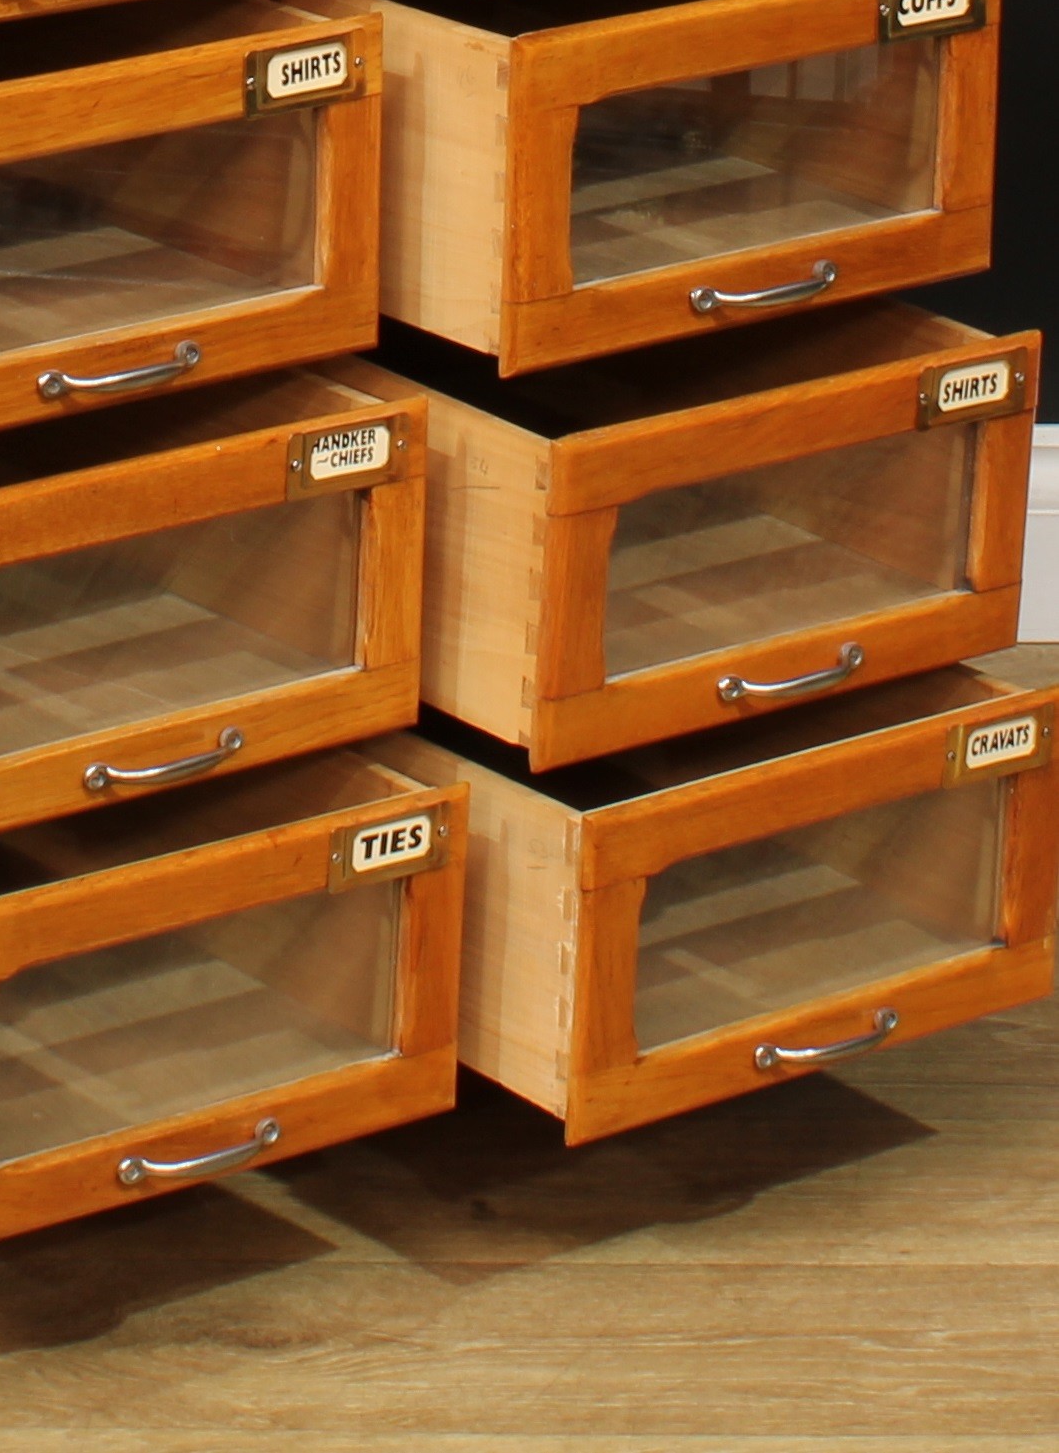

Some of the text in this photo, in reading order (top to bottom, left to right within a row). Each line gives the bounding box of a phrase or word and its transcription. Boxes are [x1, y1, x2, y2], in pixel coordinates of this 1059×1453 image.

[281, 51, 341, 85] SHIRTS
[943, 374, 998, 403] SHIRTS
[313, 429, 376, 453] HANDKER
[972, 725, 1030, 756] CRAVATS
[361, 825, 423, 860] TIES
